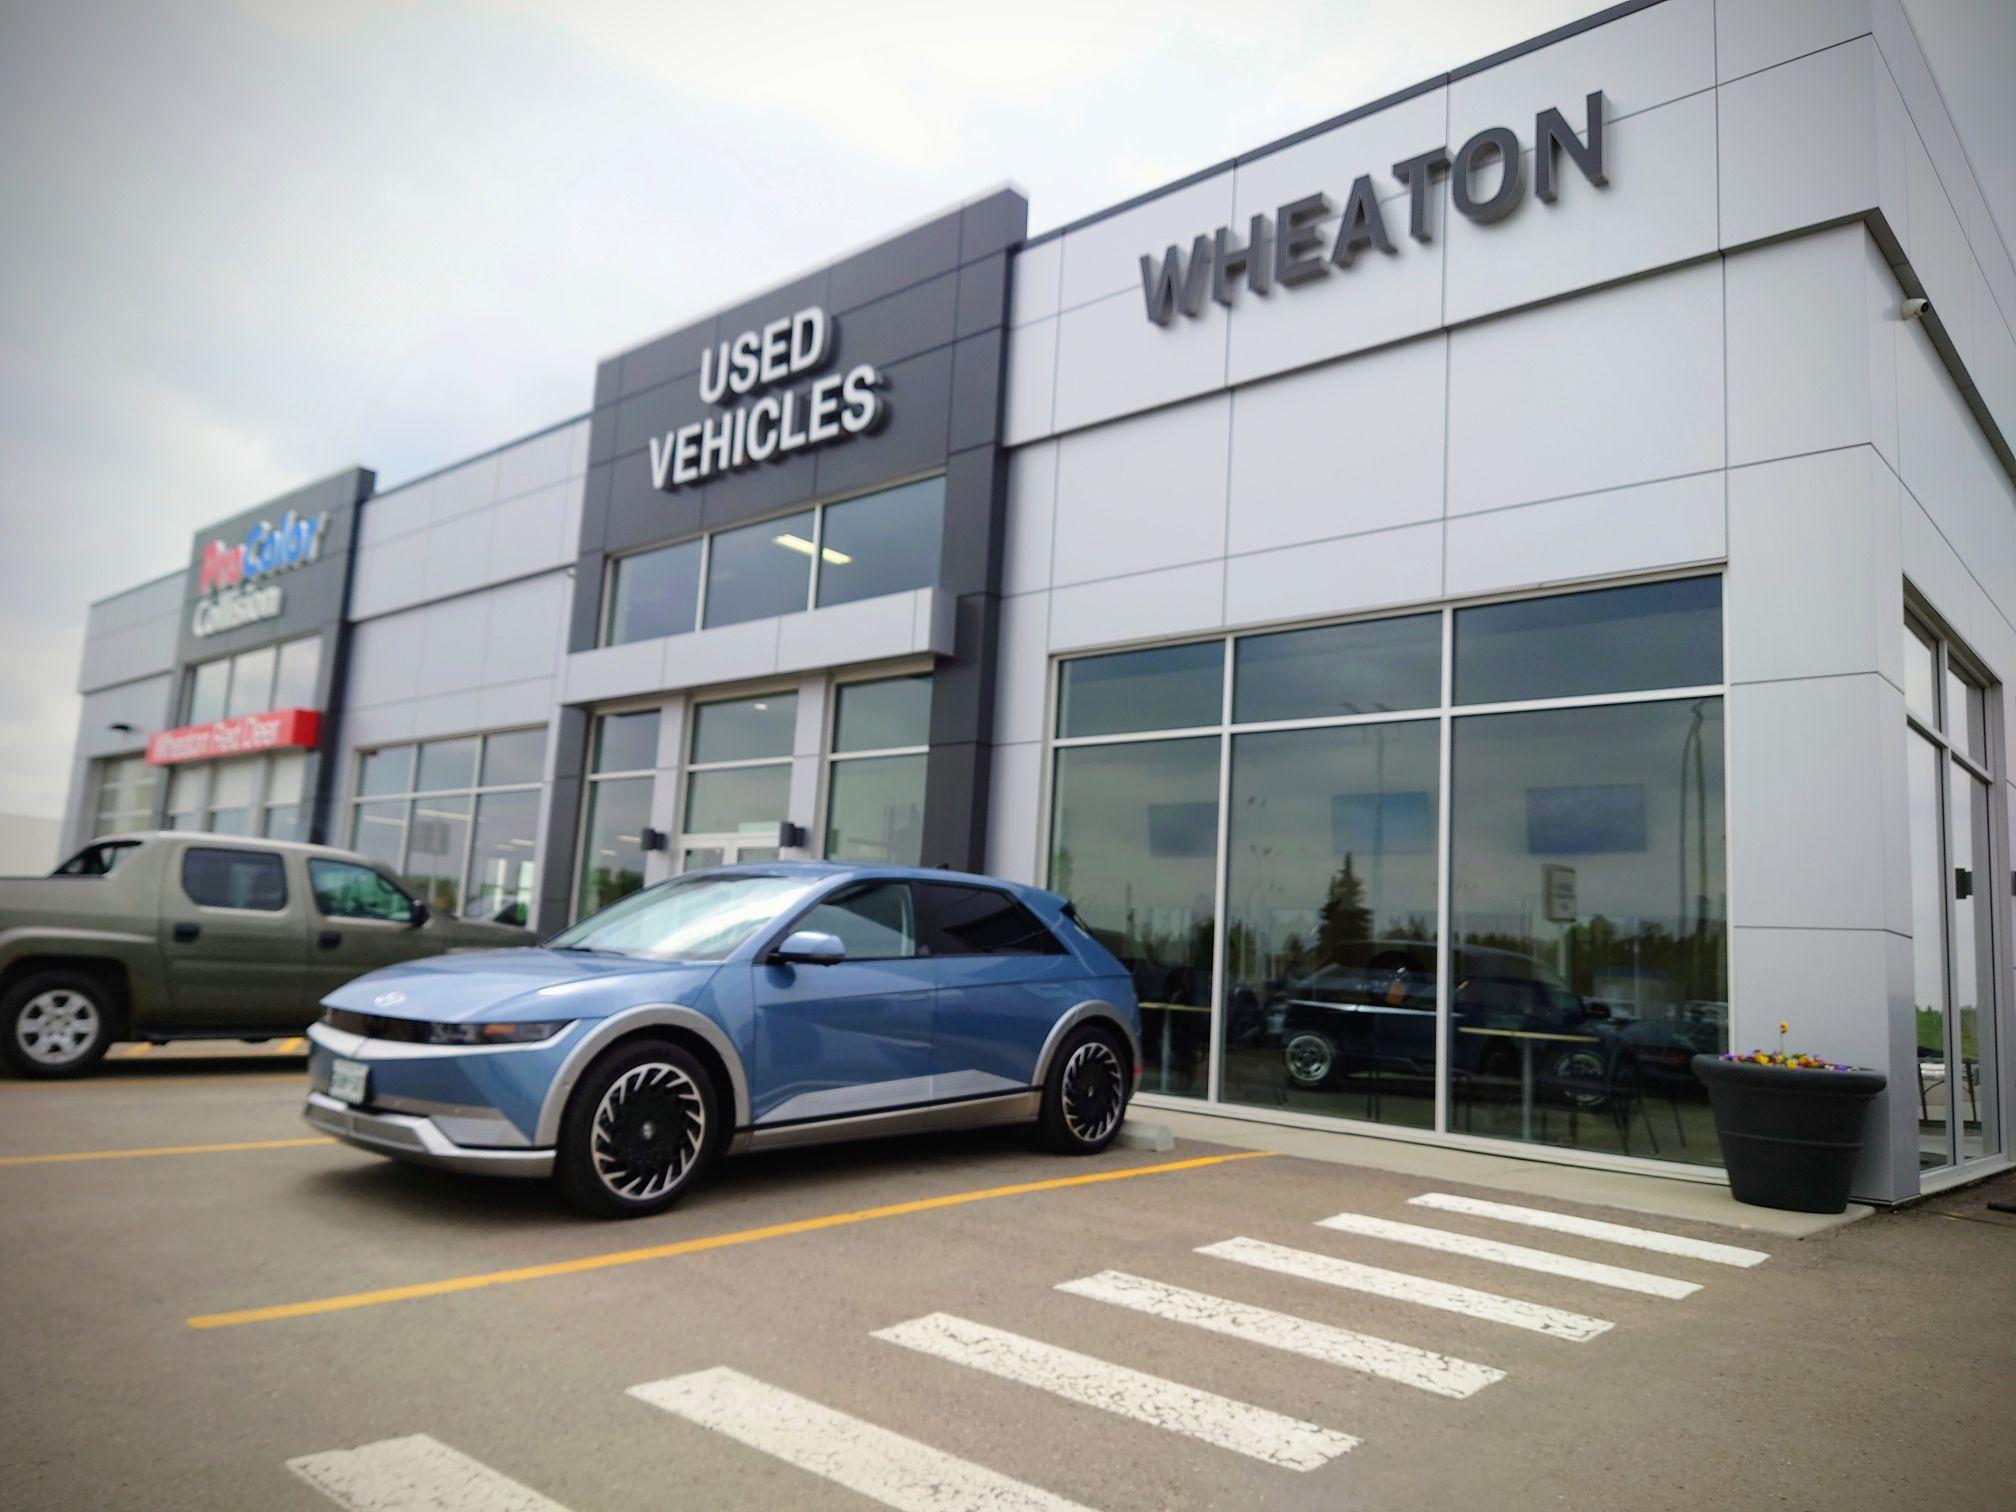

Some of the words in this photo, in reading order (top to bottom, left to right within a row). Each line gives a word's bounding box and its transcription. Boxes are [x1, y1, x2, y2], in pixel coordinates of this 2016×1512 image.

[1140, 90, 1609, 326] WHEATON
[699, 305, 829, 404] USED
[650, 363, 880, 490] VEHICLES
